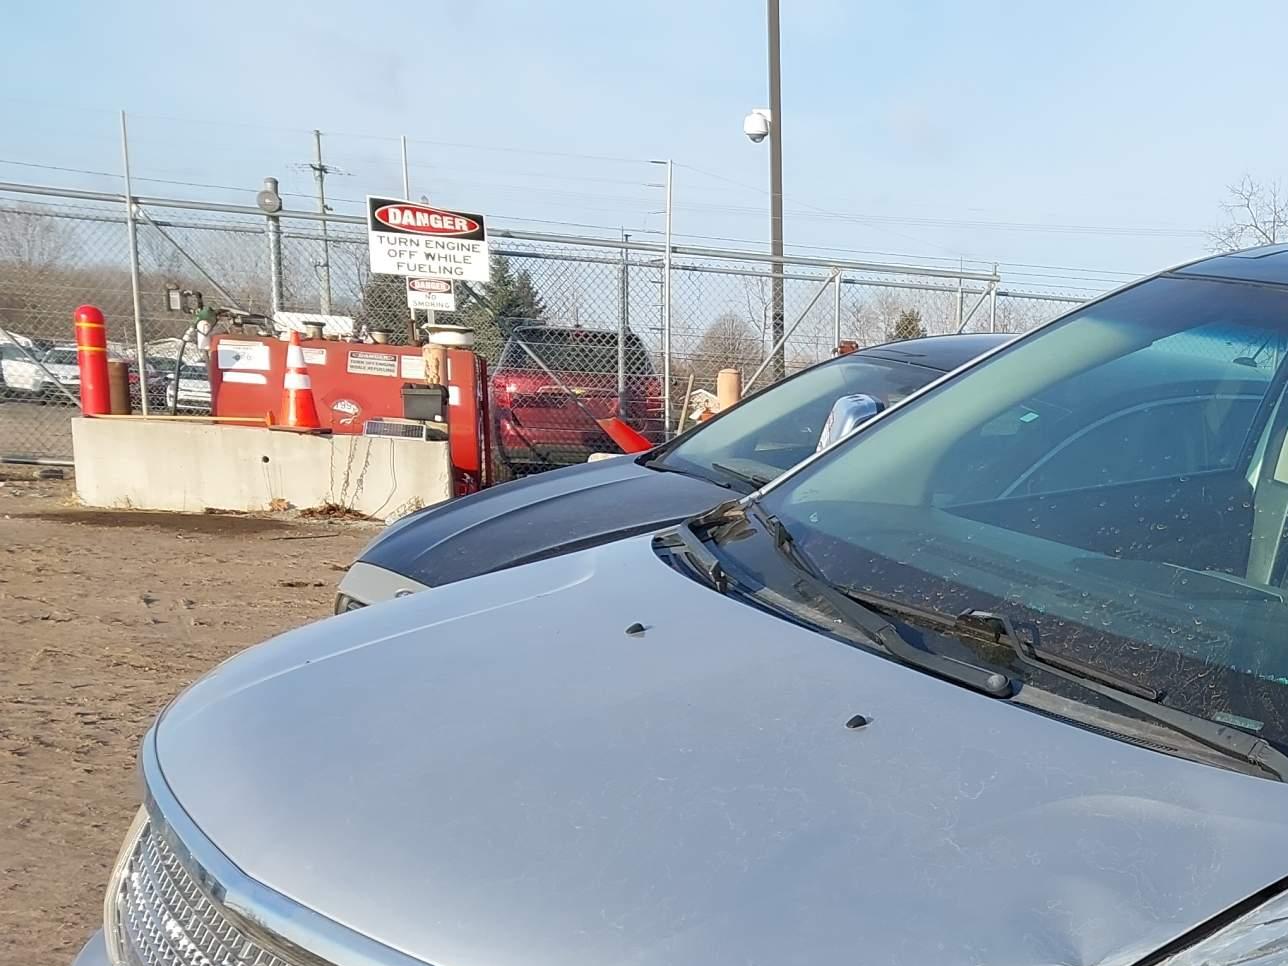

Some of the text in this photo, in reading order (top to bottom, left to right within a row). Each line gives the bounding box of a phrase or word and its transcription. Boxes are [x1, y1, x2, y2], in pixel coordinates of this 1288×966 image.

[387, 207, 469, 231] DANGER
[377, 235, 481, 253] TURN ENGINE
[387, 248, 472, 264] OFF WHILE
[397, 261, 464, 276] FUELING
[412, 300, 450, 309] SMOKING
